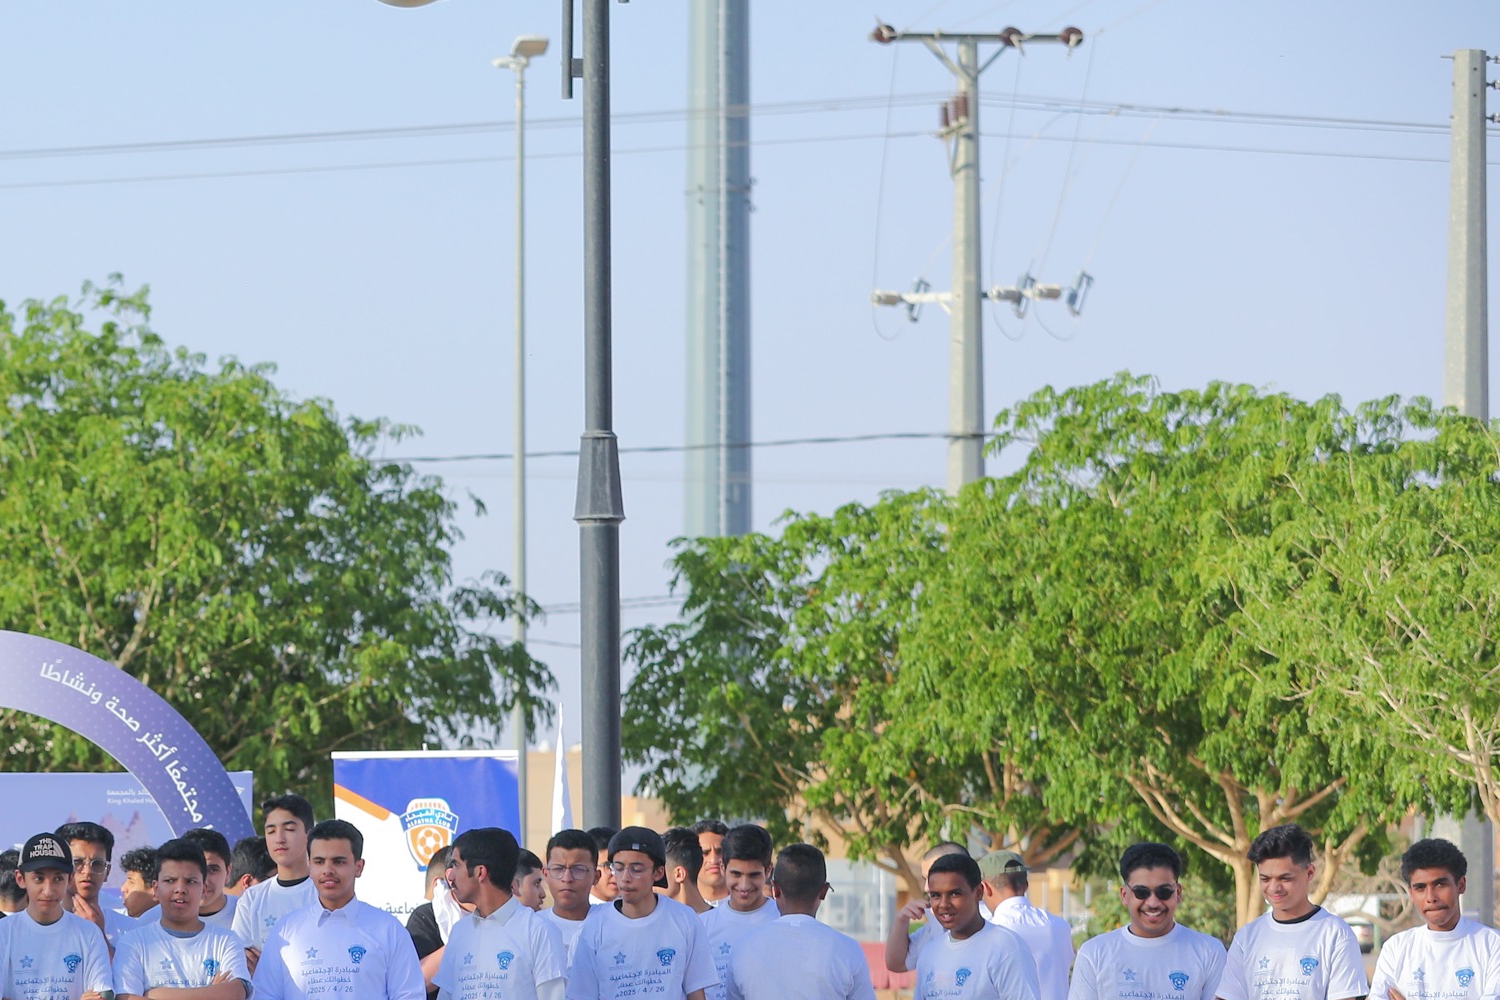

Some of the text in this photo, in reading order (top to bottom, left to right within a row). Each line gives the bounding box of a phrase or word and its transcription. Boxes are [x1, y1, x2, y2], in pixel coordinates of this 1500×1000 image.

[105, 695, 140, 732] صحة
[136, 732, 178, 762] أكثر
[107, 797, 122, 805] King
[435, 817, 451, 828] CLUB
[33, 843, 54, 851] TRAP
[29, 850, 54, 858] HOUSE
[335, 966, 360, 974] المبادرة
[614, 989, 637, 999] 2025م
[1157, 992, 1185, 1000] المبادرة
